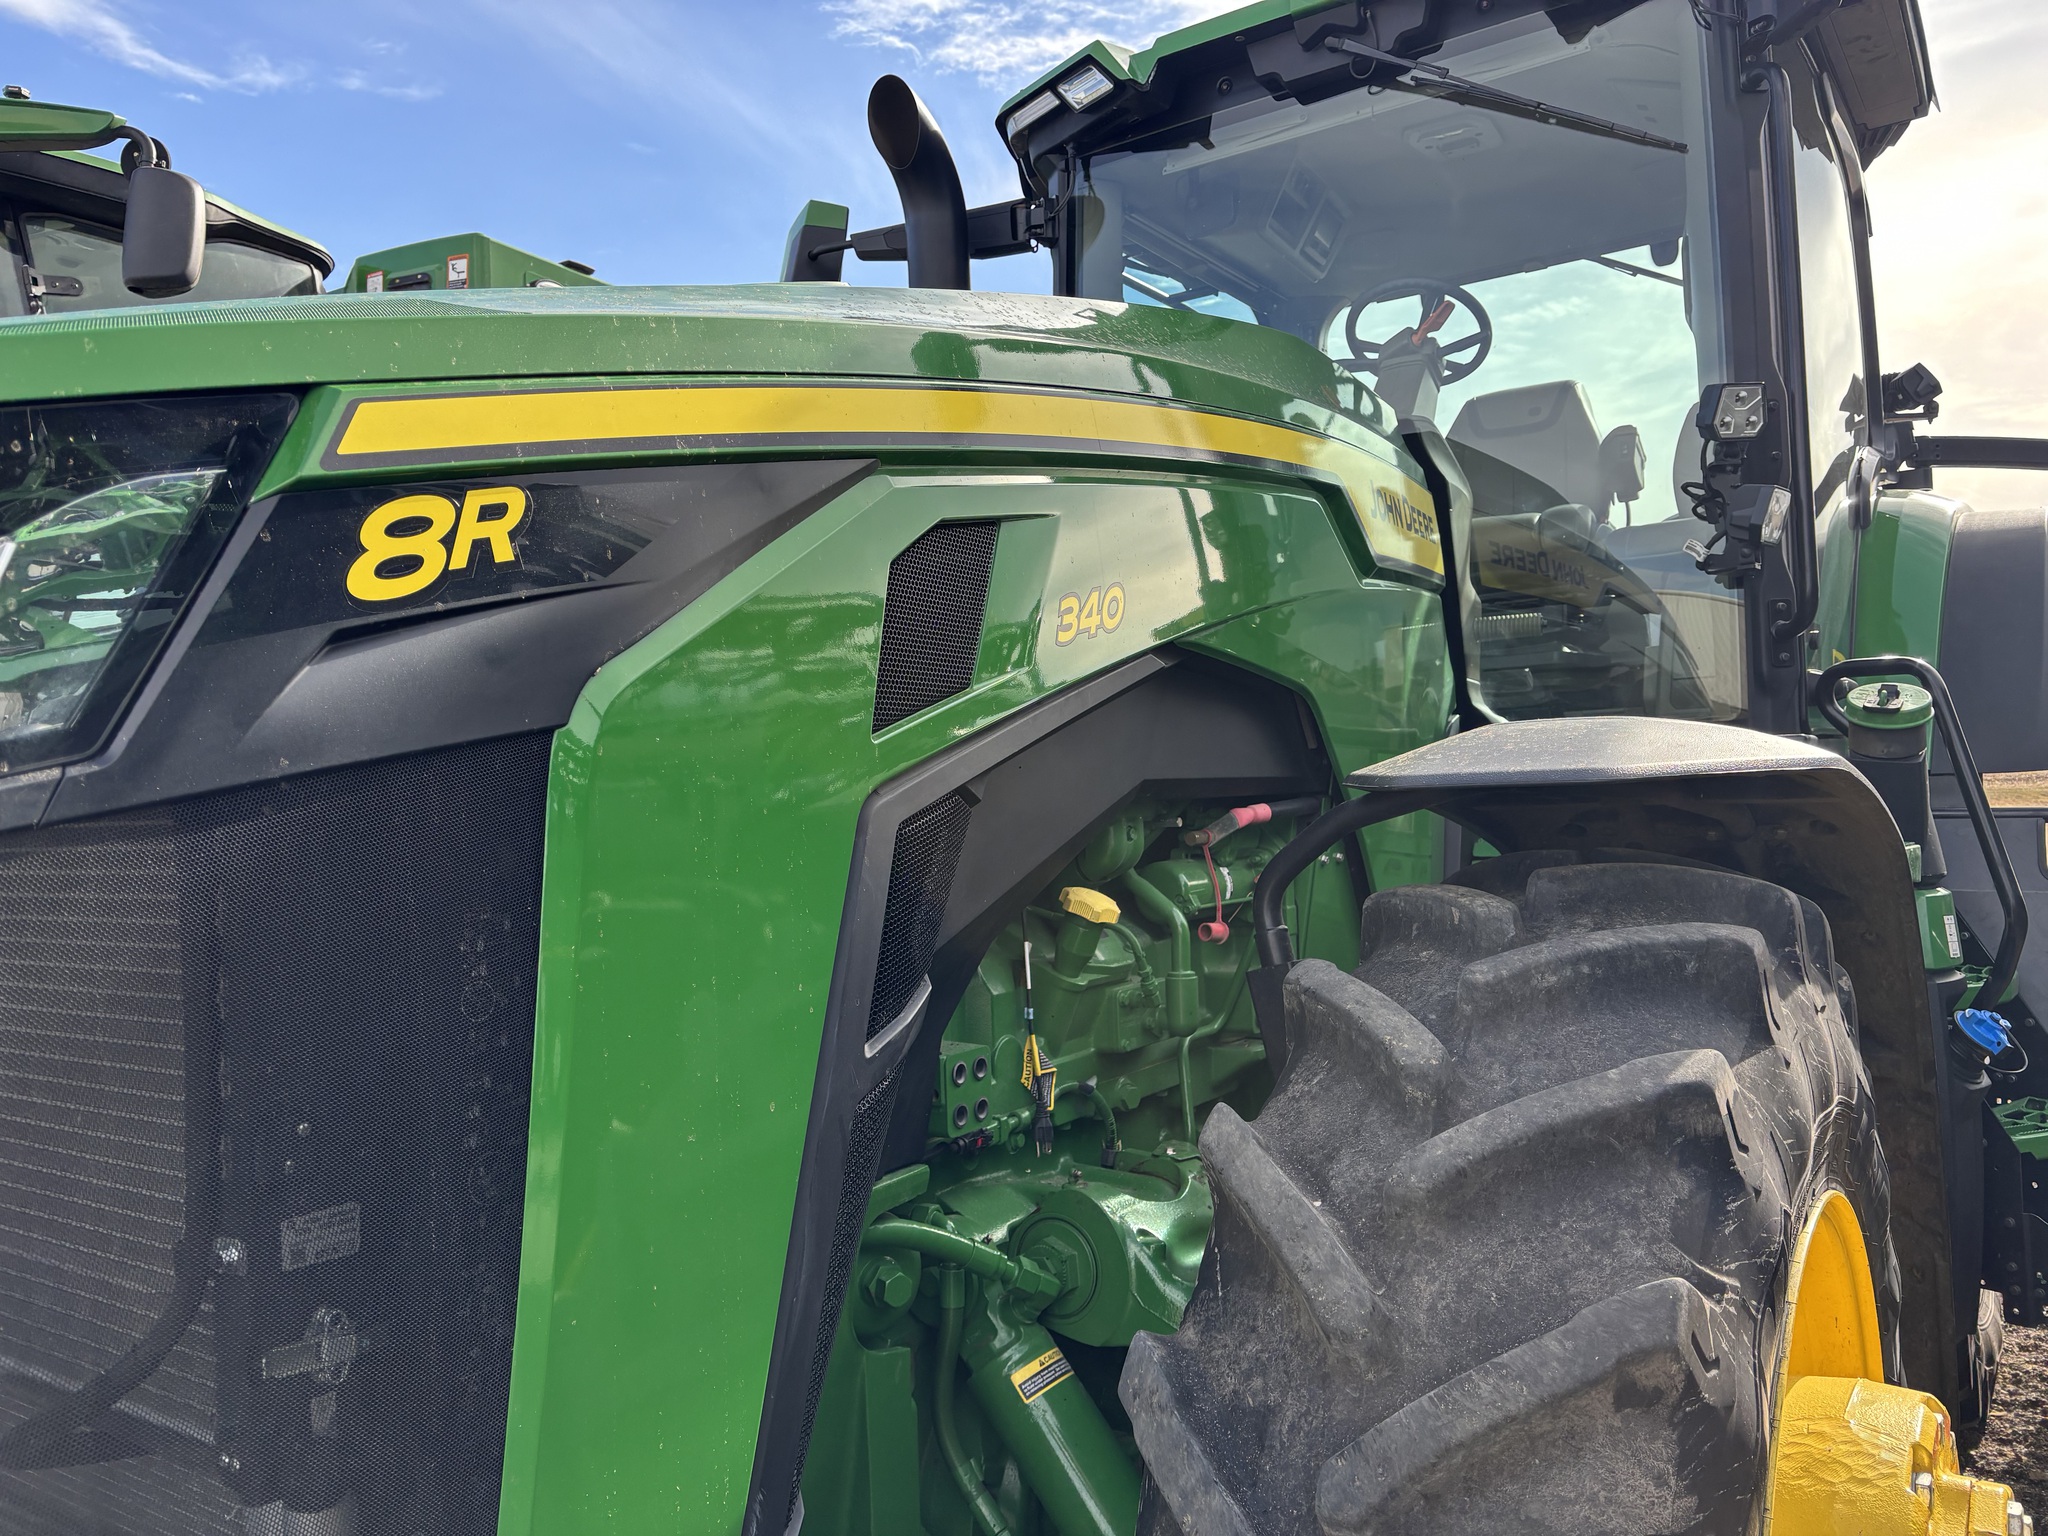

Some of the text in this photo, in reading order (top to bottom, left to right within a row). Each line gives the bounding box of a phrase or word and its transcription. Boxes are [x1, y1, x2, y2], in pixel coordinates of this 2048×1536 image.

[346, 486, 526, 601] 8R
[1370, 480, 1437, 545] JOHN DEERE
[1056, 583, 1125, 646] 340
